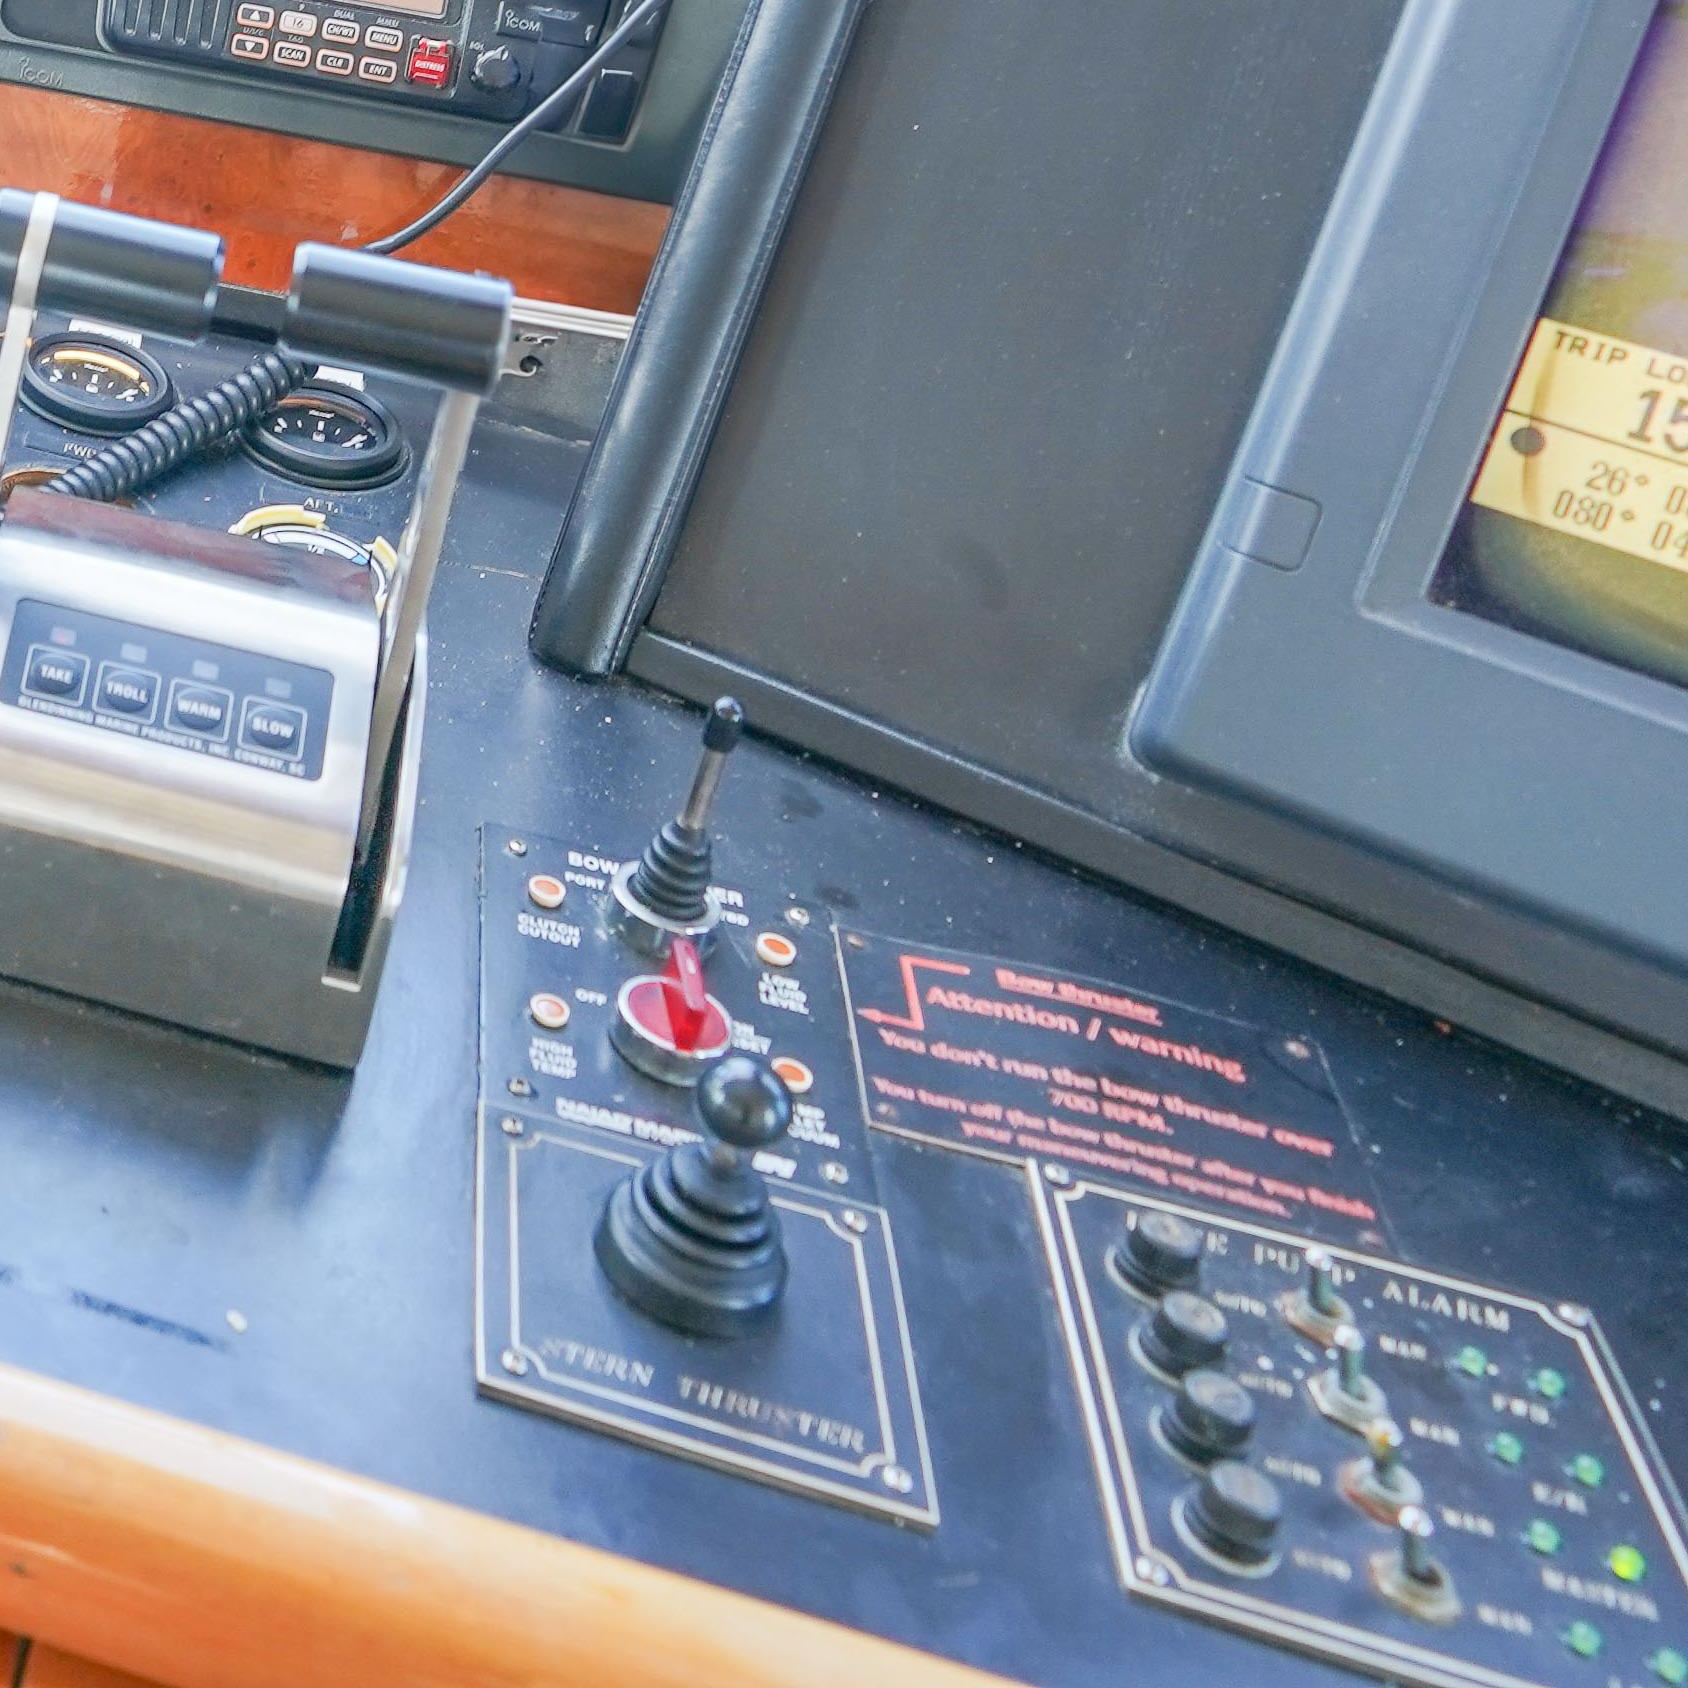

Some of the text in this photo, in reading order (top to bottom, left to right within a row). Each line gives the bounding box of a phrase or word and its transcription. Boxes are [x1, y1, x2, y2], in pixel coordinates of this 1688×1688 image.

[371, 32, 398, 46] MENU
[280, 49, 304, 62] SCAN
[1554, 329, 1632, 366] TRIP
[1585, 461, 1651, 497] 26°
[1553, 488, 1636, 532] 080°
[39, 663, 73, 684] TAKE
[105, 680, 149, 703] TROLL
[177, 698, 222, 721] WARM
[251, 714, 295, 739] SLOW
[567, 851, 622, 875] BOW
[564, 871, 606, 891] PORT
[995, 967, 1054, 996] Bow
[575, 987, 607, 1006] OFF
[926, 986, 1081, 1035] Attention
[1108, 1027, 1246, 1084] warning
[878, 1027, 927, 1055] You
[929, 1041, 999, 1072] don't
[1000, 1058, 1049, 1082] run
[1051, 1066, 1098, 1093] the
[1099, 1076, 1160, 1109] bow
[872, 1075, 916, 1102] You
[1005, 1108, 1046, 1131] the
[1046, 1116, 1102, 1144] bow
[1047, 1087, 1099, 1114] 700
[1380, 1278, 1512, 1334] ALARM
[678, 1374, 866, 1455] THRUSTER
